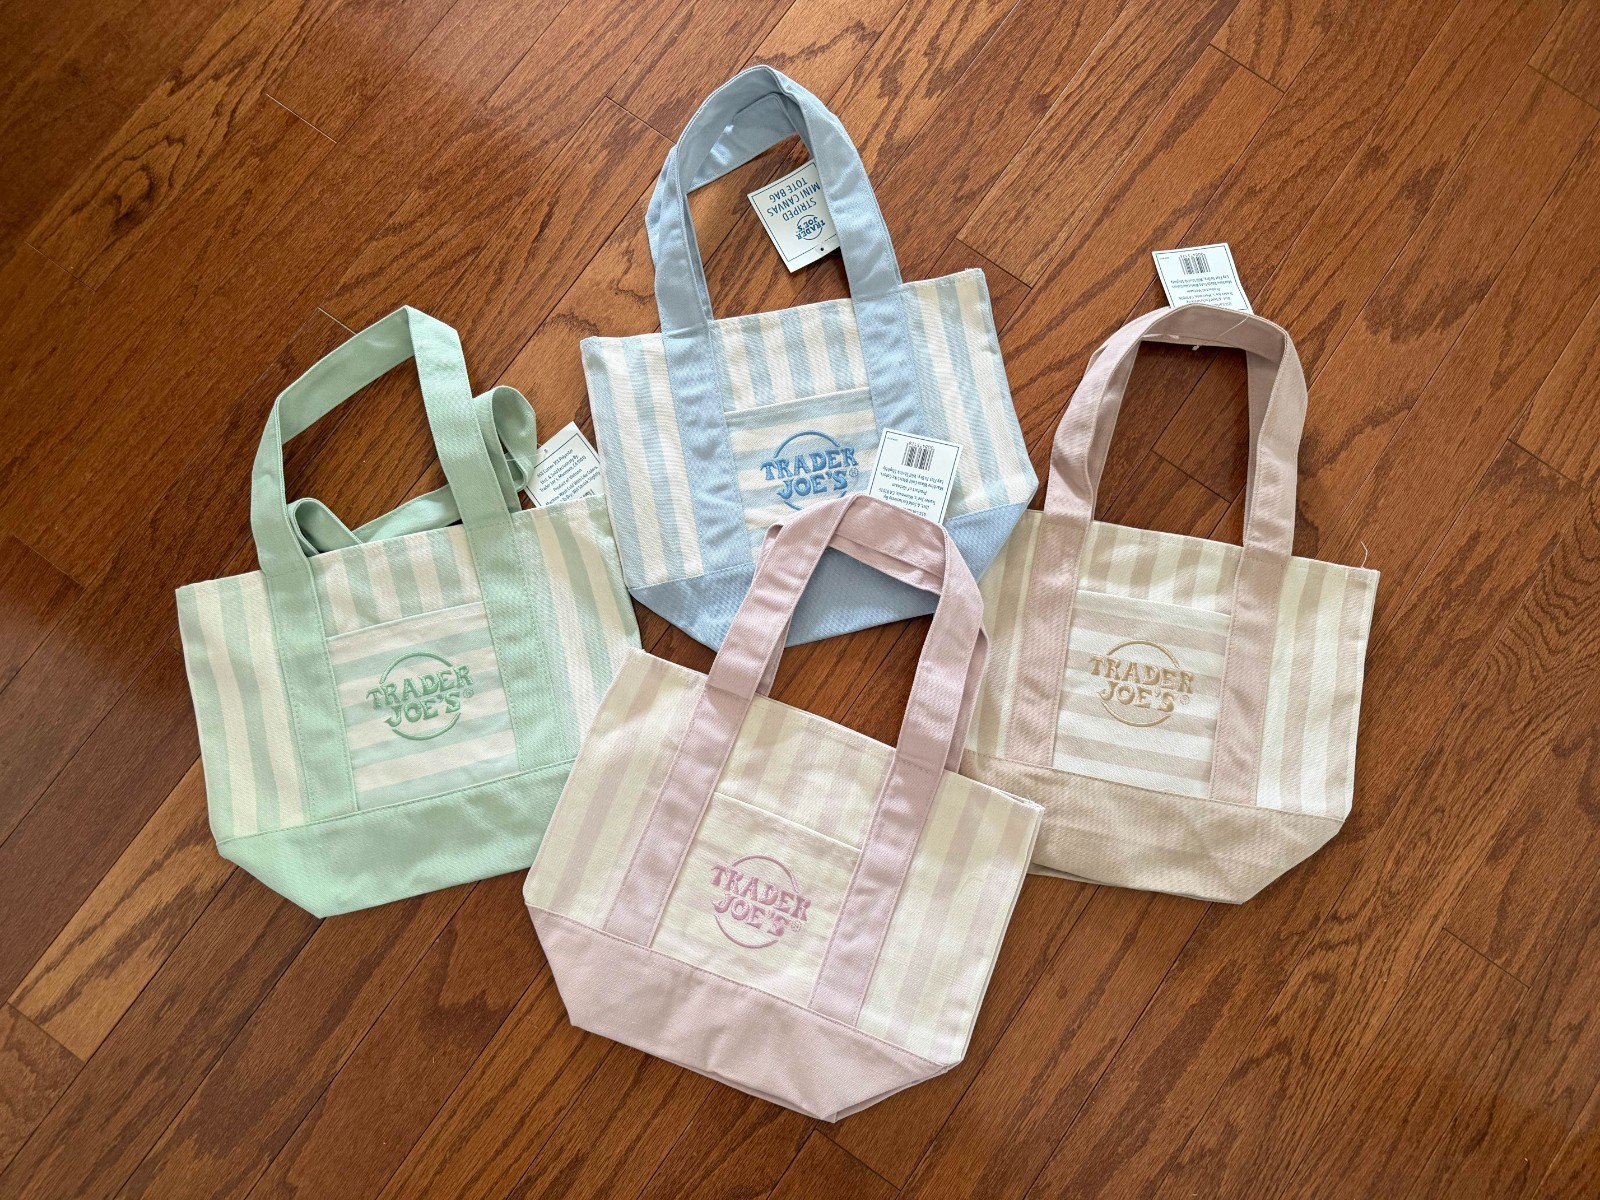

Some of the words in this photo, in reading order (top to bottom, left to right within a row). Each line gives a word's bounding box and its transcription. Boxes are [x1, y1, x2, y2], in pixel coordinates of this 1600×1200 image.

[769, 189, 787, 203] BAG
[786, 177, 808, 193] TOTE
[800, 181, 822, 198] MINI
[767, 194, 800, 216] CANVAS
[782, 197, 817, 221] STRIPED
[796, 220, 826, 240] TRADER
[797, 216, 818, 232] JOE'S
[760, 447, 858, 480] TRADER
[777, 470, 848, 499] JOE'S
[366, 665, 473, 710] TRADER
[1089, 655, 1193, 694] TRADER
[384, 691, 460, 727] JOE'S
[1097, 681, 1178, 712] JOE'S
[711, 863, 811, 921] TRADER
[712, 894, 790, 937] JOE'S
